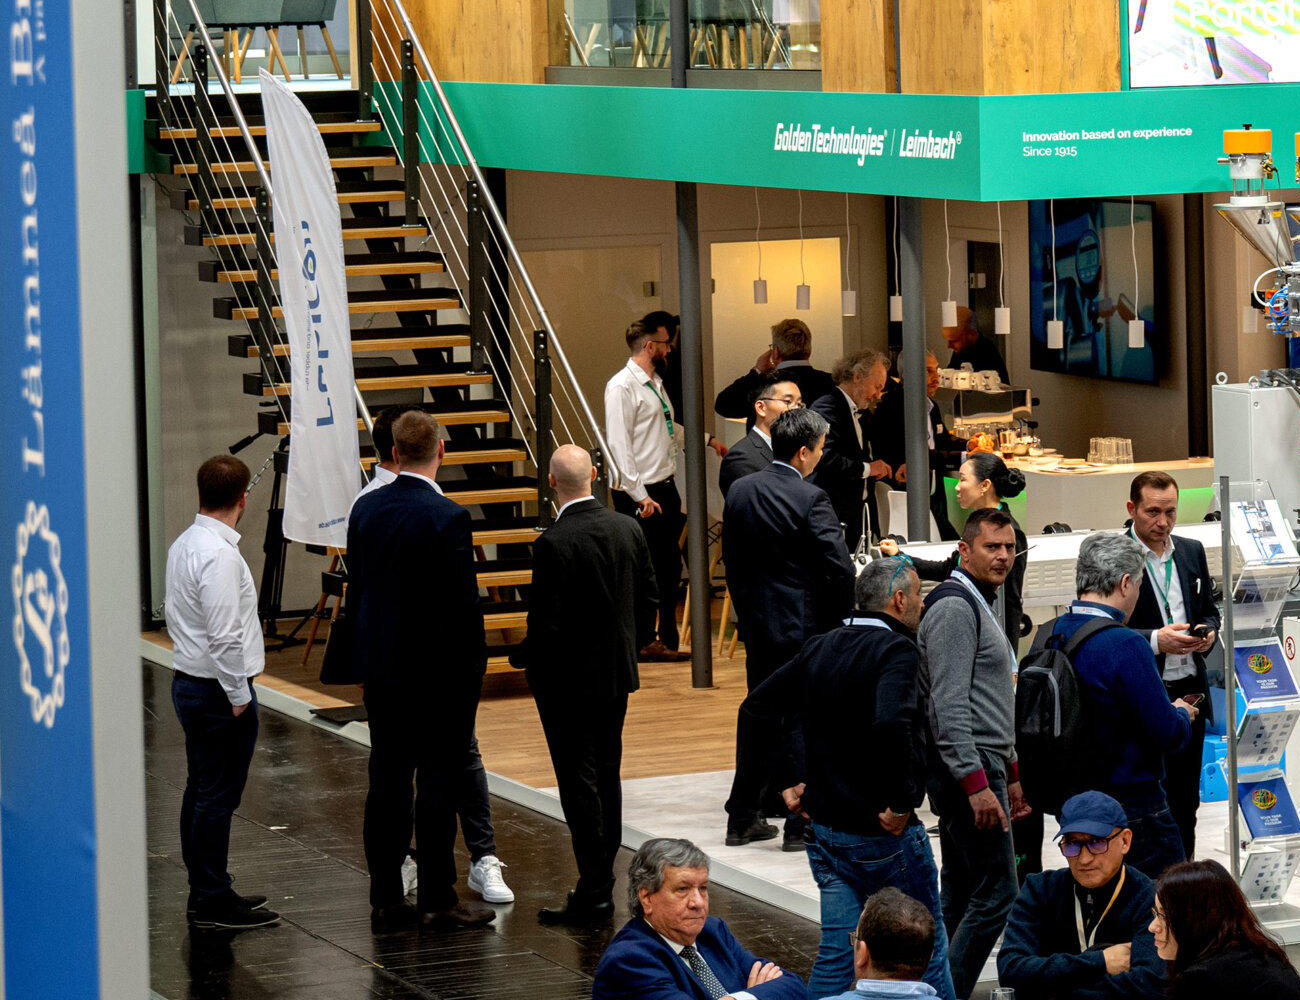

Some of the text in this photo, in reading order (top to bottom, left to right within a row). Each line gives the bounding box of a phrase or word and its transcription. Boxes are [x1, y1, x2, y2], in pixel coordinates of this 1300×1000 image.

[34, 56, 46, 83] A
[774, 122, 812, 152] Golden
[1022, 126, 1193, 142] Innovation based on experience
[1023, 146, 1078, 157] Since 1915
[13, 106, 45, 477] Lämneå
